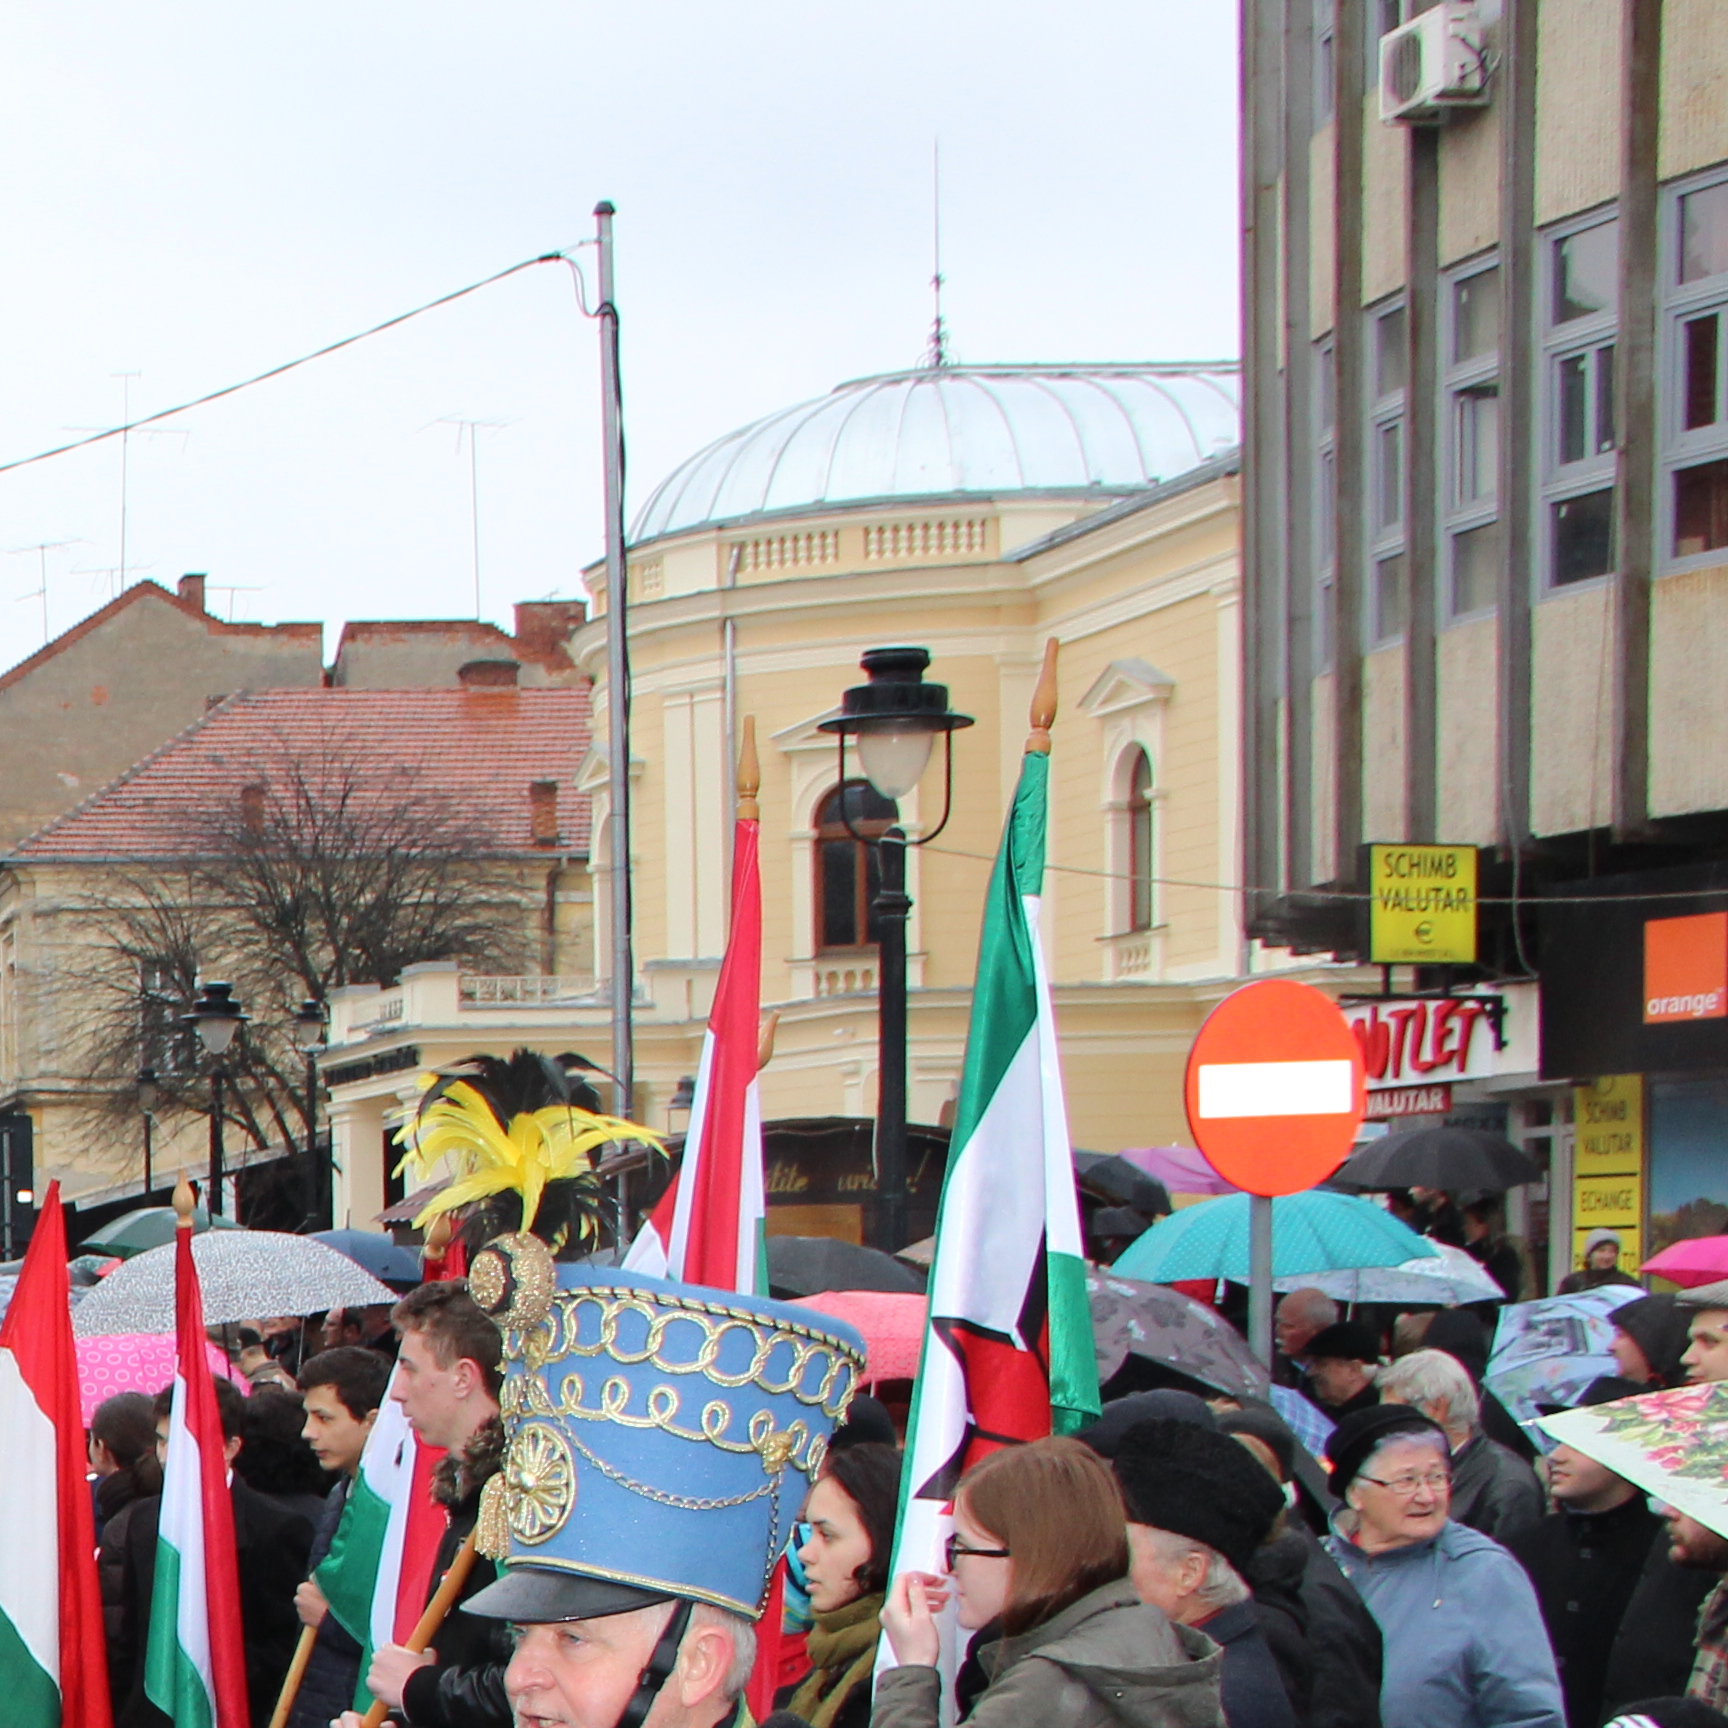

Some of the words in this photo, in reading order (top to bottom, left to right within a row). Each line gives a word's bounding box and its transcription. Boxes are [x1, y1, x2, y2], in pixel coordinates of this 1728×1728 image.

[1384, 852, 1457, 879] SCHIMB
[1378, 887, 1470, 913] VALUTAR
[1647, 992, 1718, 1017] orange
[1580, 1190, 1633, 1212] ECHANGE
